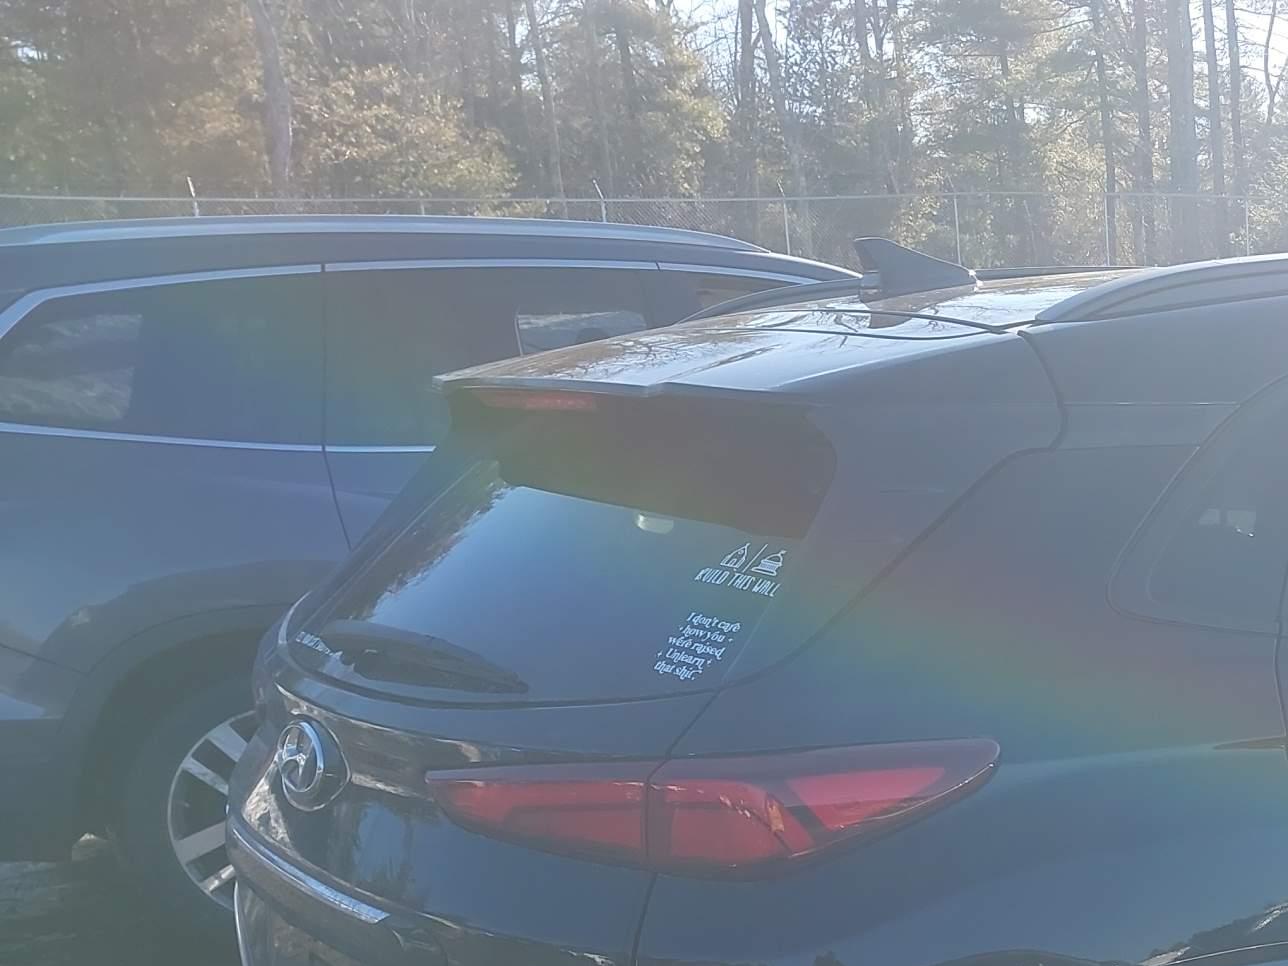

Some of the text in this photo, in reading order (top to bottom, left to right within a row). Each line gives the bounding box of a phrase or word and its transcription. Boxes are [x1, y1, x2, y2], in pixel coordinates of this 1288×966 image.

[727, 572, 756, 591] THIS
[751, 578, 781, 598] WALL
[682, 624, 727, 643] how you
[686, 612, 741, 633] I don't care
[665, 647, 706, 670] Unlearn
[668, 636, 726, 660] were raised
[653, 660, 676, 674] that
